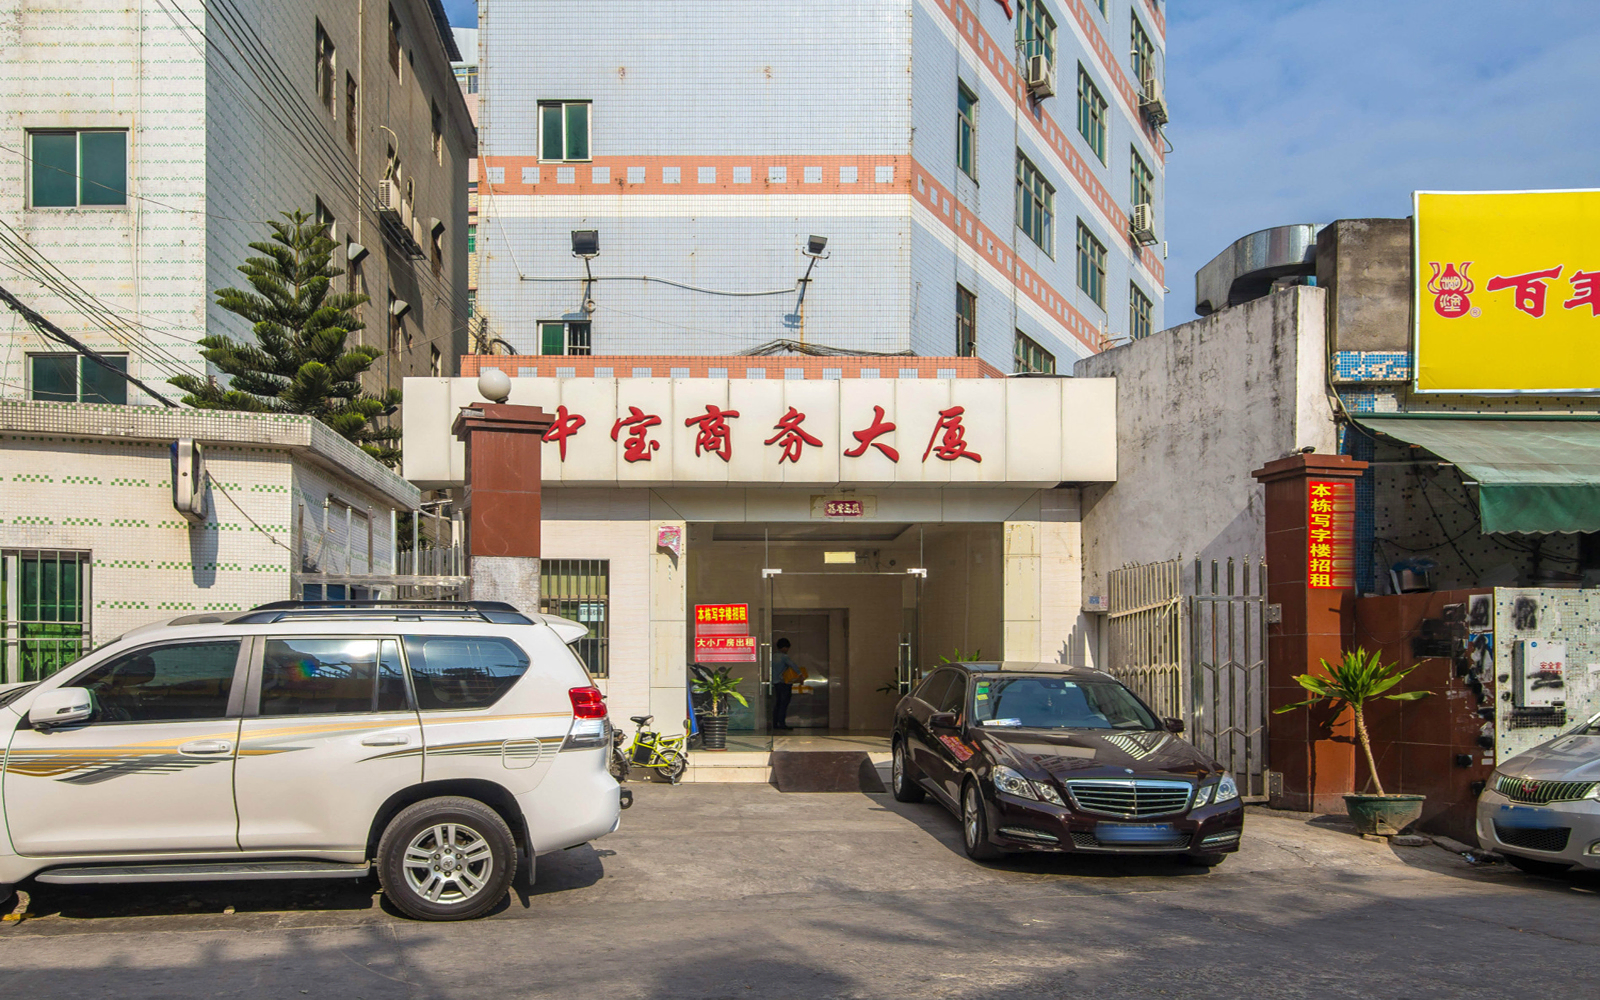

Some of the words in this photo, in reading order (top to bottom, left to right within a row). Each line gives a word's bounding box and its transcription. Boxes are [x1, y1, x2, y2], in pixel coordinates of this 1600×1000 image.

[542, 404, 982, 464] 中宝商务大厦
[1309, 483, 1332, 587] 本栋写字楼招租
[697, 606, 746, 621] 本栋写字楼招租
[697, 638, 754, 647] 大小厂房出租
